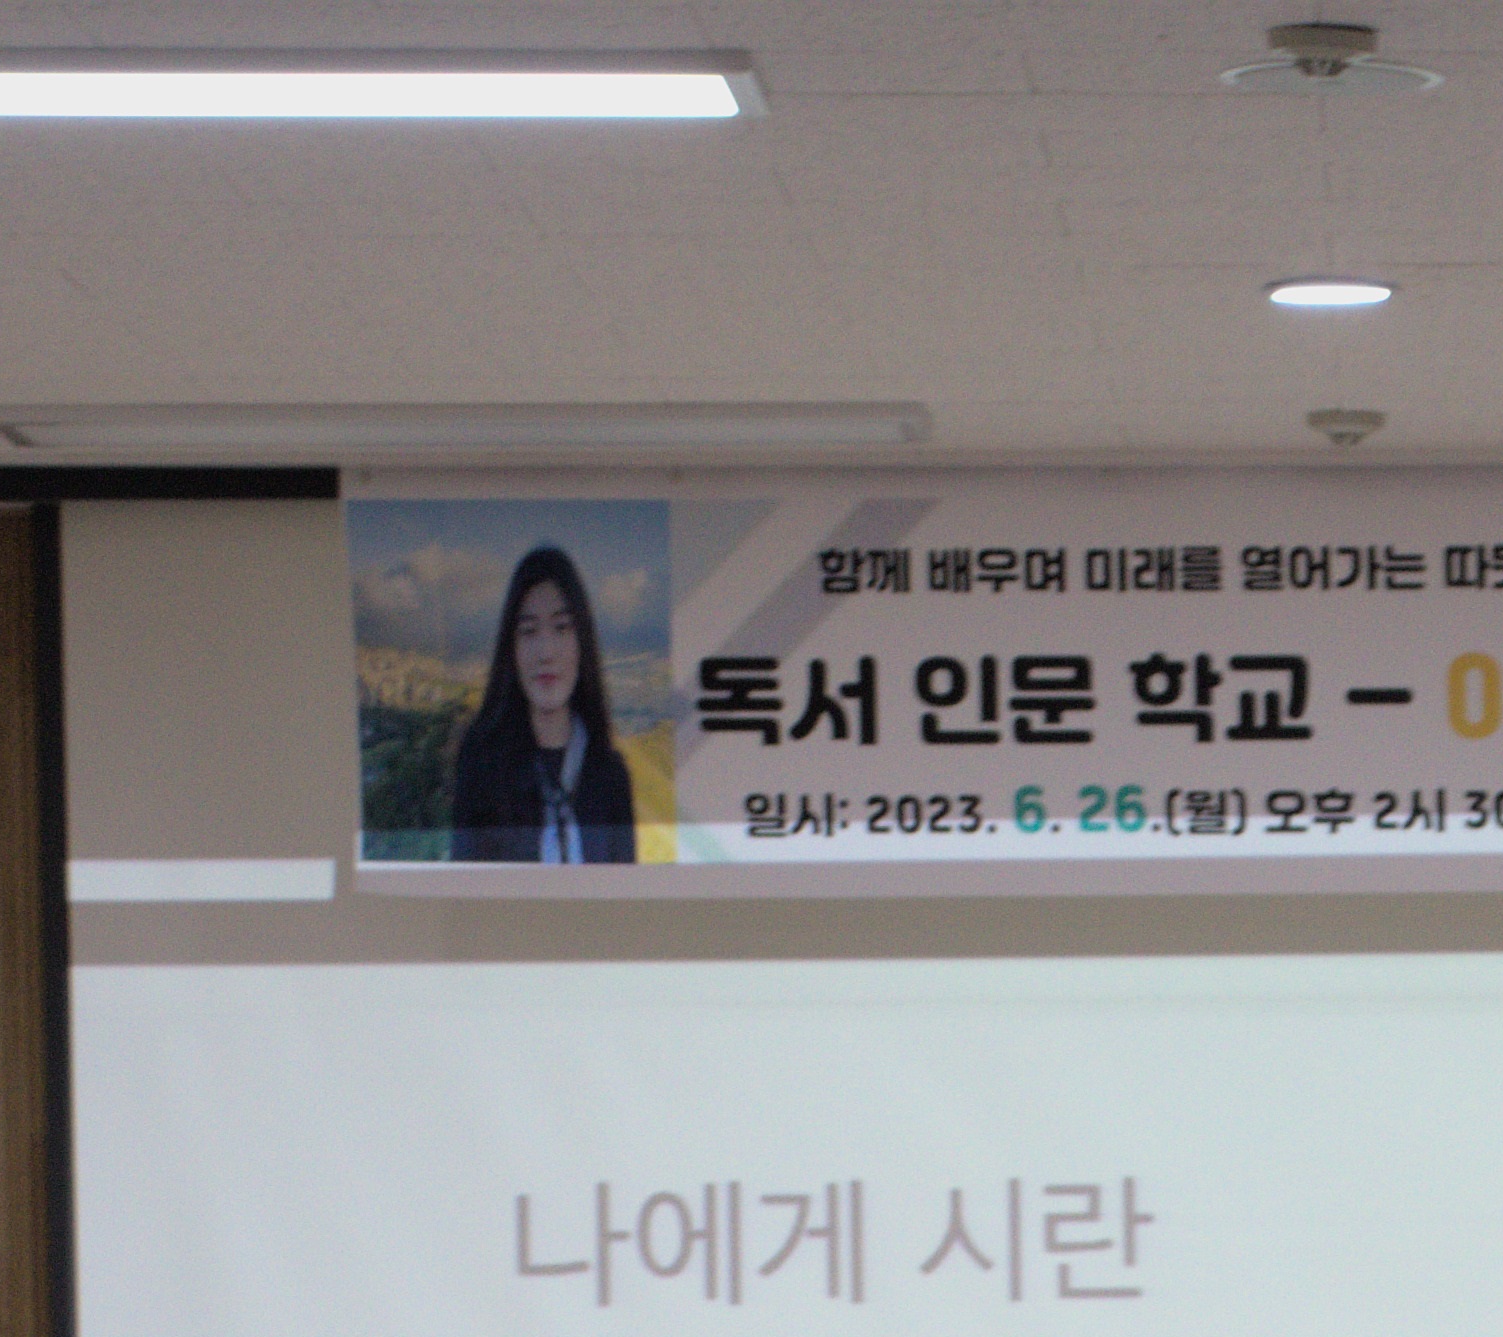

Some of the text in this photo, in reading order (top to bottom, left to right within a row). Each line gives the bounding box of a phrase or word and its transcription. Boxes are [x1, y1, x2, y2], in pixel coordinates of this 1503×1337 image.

[818, 549, 910, 594] 함께
[929, 548, 1066, 593] 배우며
[1085, 547, 1220, 591] 미래를
[1241, 546, 1425, 591] 열어가는
[697, 656, 877, 746] 독서
[915, 656, 1094, 745] 인문
[1129, 653, 1312, 743] 학교
[744, 793, 848, 838] 일시:
[867, 795, 995, 835] 2023.
[1266, 789, 1354, 834] 오후
[1374, 789, 1445, 832] 2시
[515, 1176, 1154, 1307] 나에게 시란
